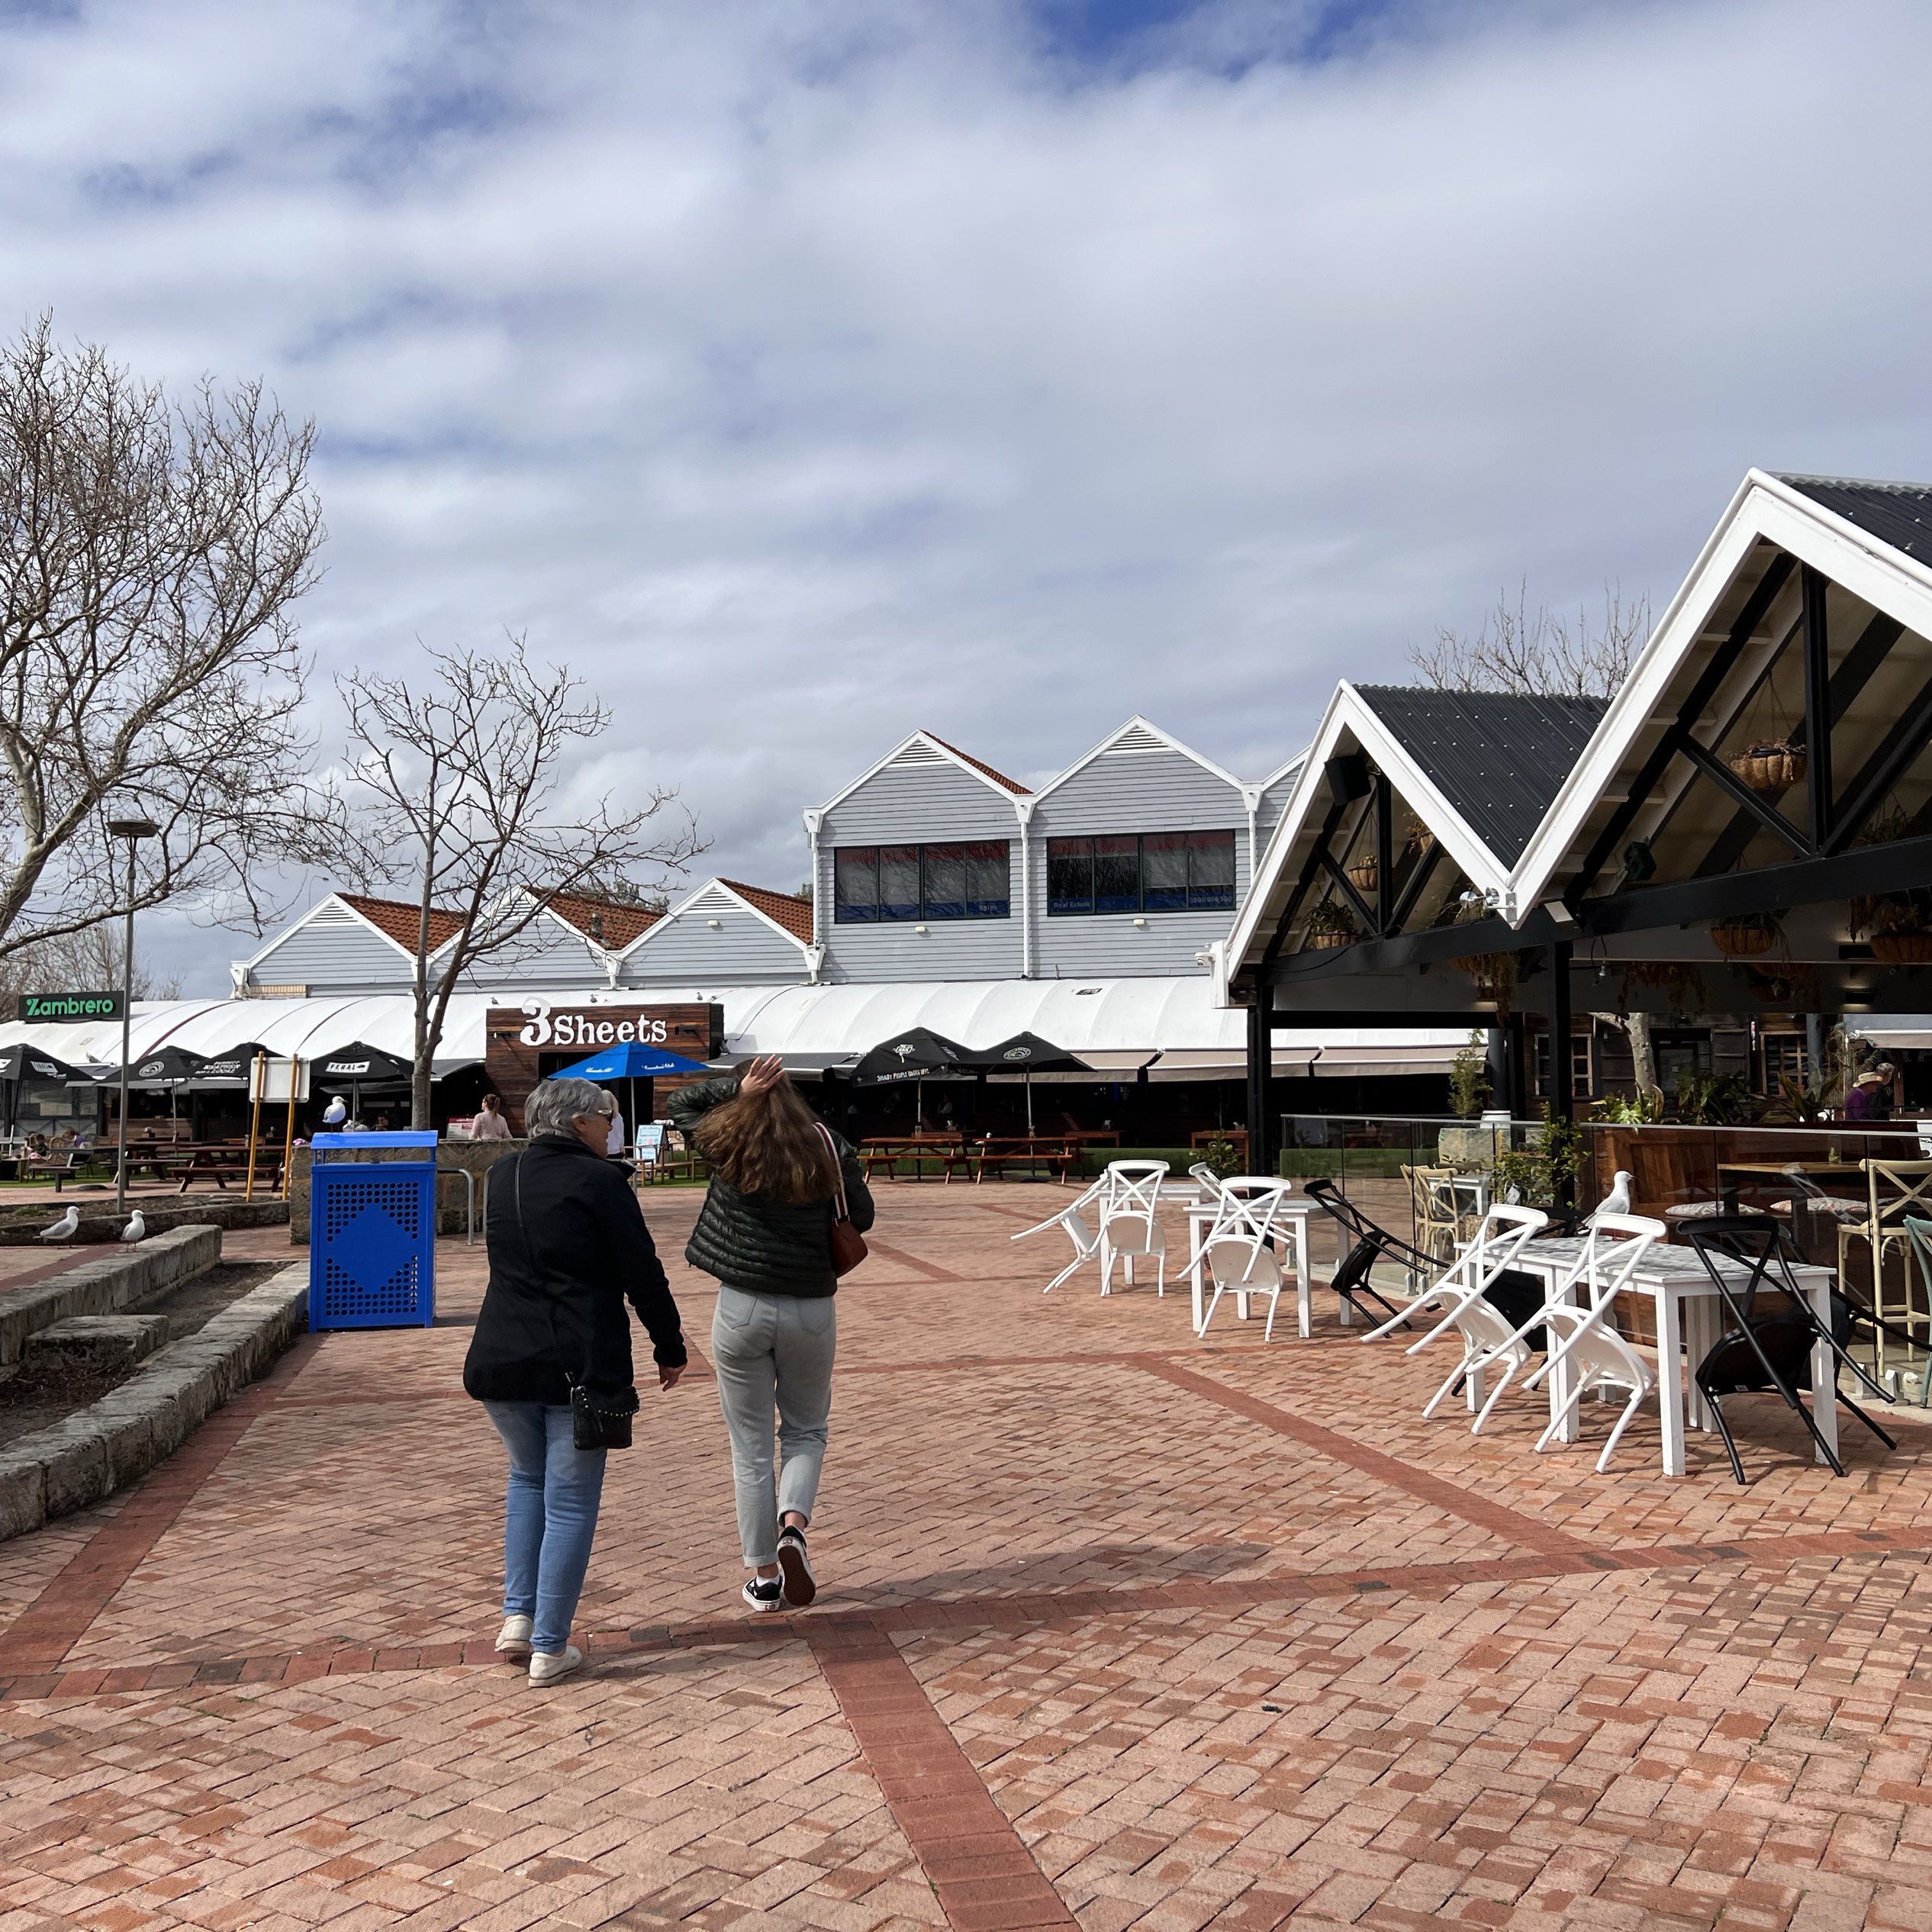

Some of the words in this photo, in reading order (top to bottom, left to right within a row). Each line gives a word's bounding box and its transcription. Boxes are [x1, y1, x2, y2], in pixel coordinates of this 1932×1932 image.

[26, 997, 114, 1016] Zambrero
[520, 996, 552, 1046] 3
[554, 1013, 668, 1045] Sheets
